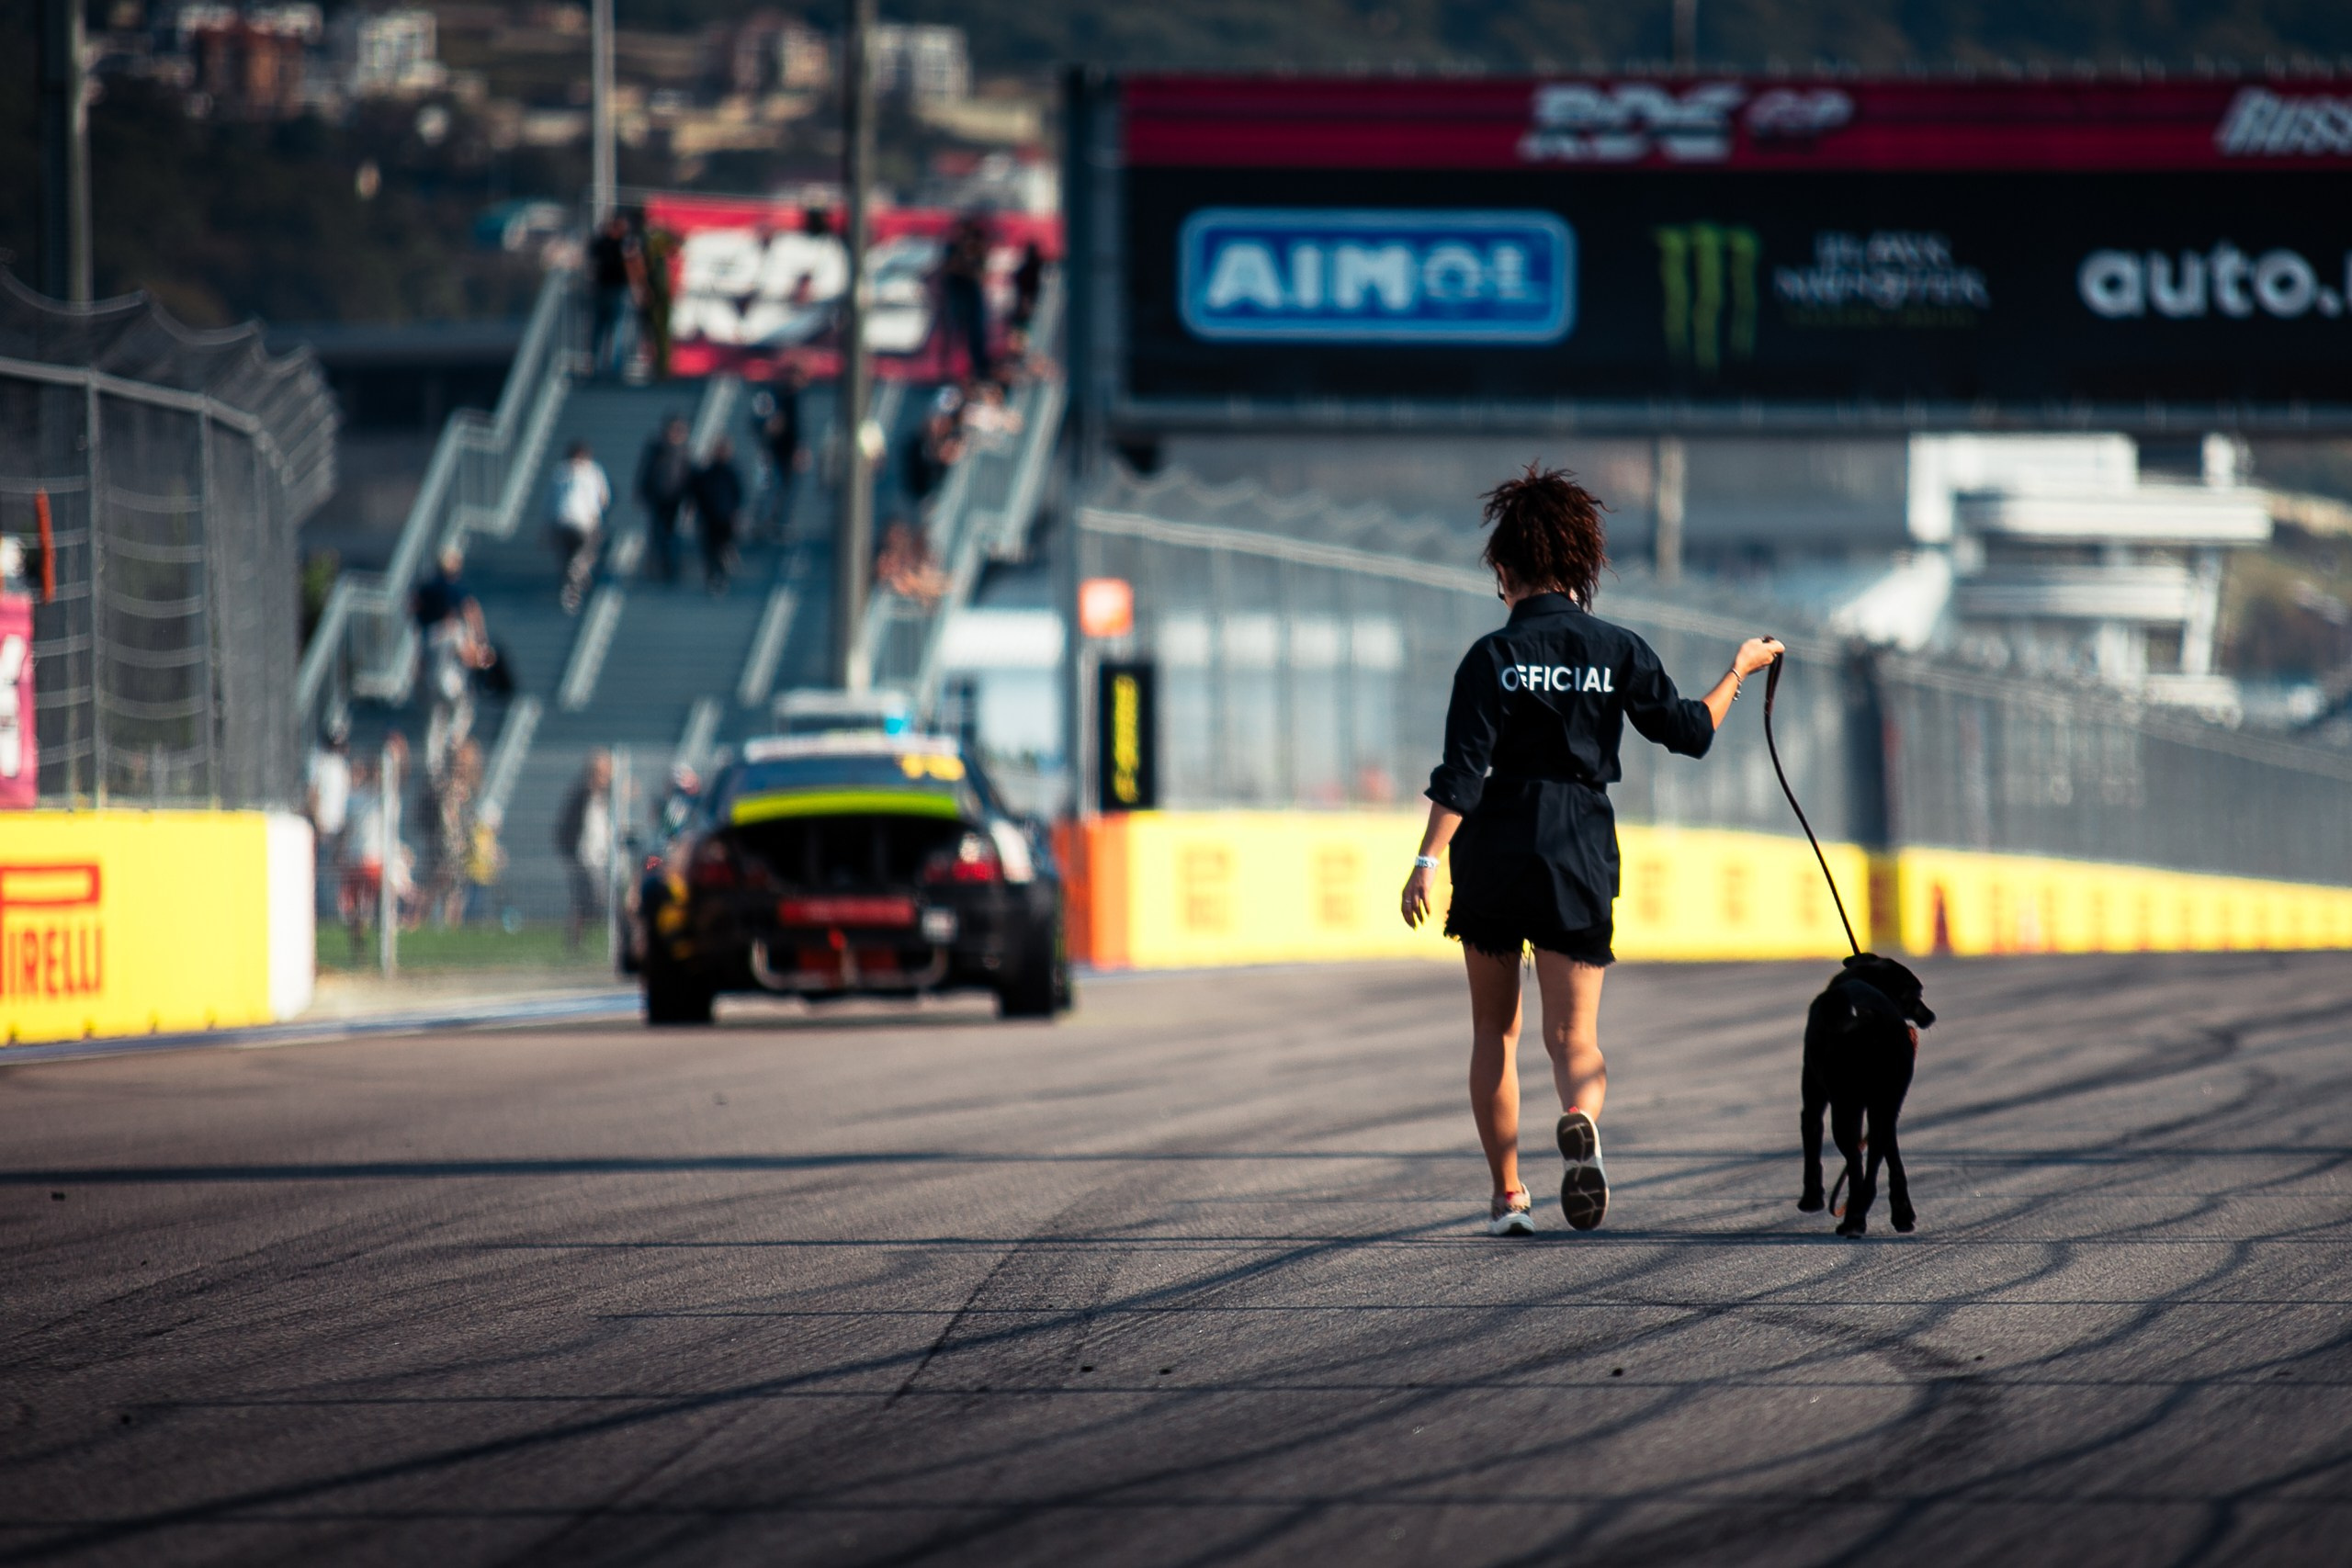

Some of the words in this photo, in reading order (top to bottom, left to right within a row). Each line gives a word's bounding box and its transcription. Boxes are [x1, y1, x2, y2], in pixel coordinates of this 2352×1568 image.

[1204, 243, 1538, 312] AIMOL
[2076, 238, 2352, 320] auto.
[1501, 664, 1614, 692] OFFICIAL
